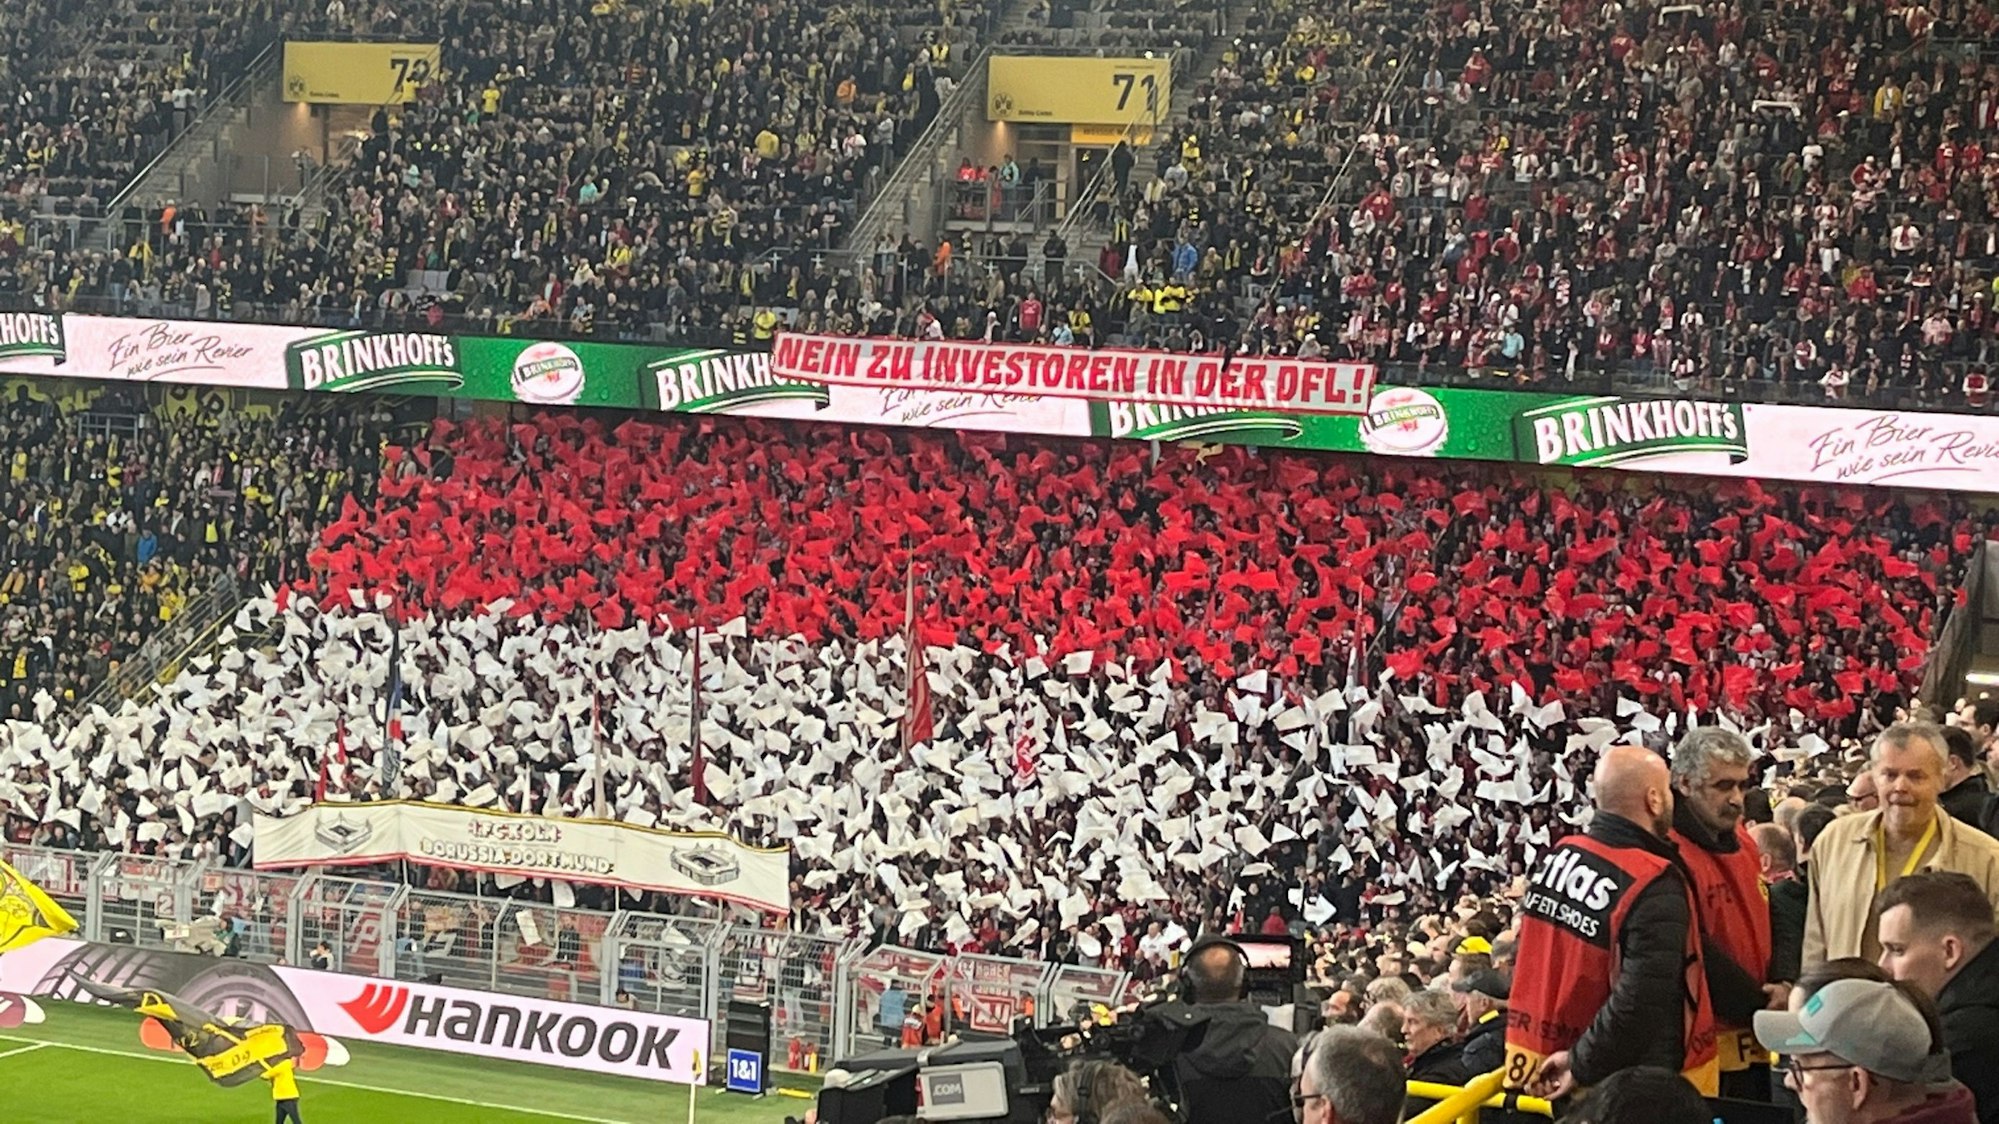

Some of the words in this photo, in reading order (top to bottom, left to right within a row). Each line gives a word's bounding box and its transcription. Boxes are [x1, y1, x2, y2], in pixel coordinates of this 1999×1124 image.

[1113, 74, 1154, 111] 71
[108, 334, 139, 371] Ein
[140, 322, 192, 350] Bier
[127, 357, 153, 378] wie
[156, 349, 187, 367] sein
[191, 335, 253, 364] Revier
[777, 337, 861, 377] NEIN
[867, 344, 915, 380] ZU
[923, 345, 1140, 394] INVESTOREN
[1147, 358, 1188, 395] IN
[1195, 362, 1268, 400] DER
[1276, 365, 1366, 404] DFL!
[902, 403, 932, 422] wie
[936, 392, 973, 411] sein
[1809, 428, 1855, 472] Ein
[1855, 414, 1934, 449] Bier
[1837, 456, 1873, 479] wie
[1880, 446, 1925, 468] sein
[1556, 903, 1600, 938] SHOES
[731, 1058, 757, 1081] 1&1
